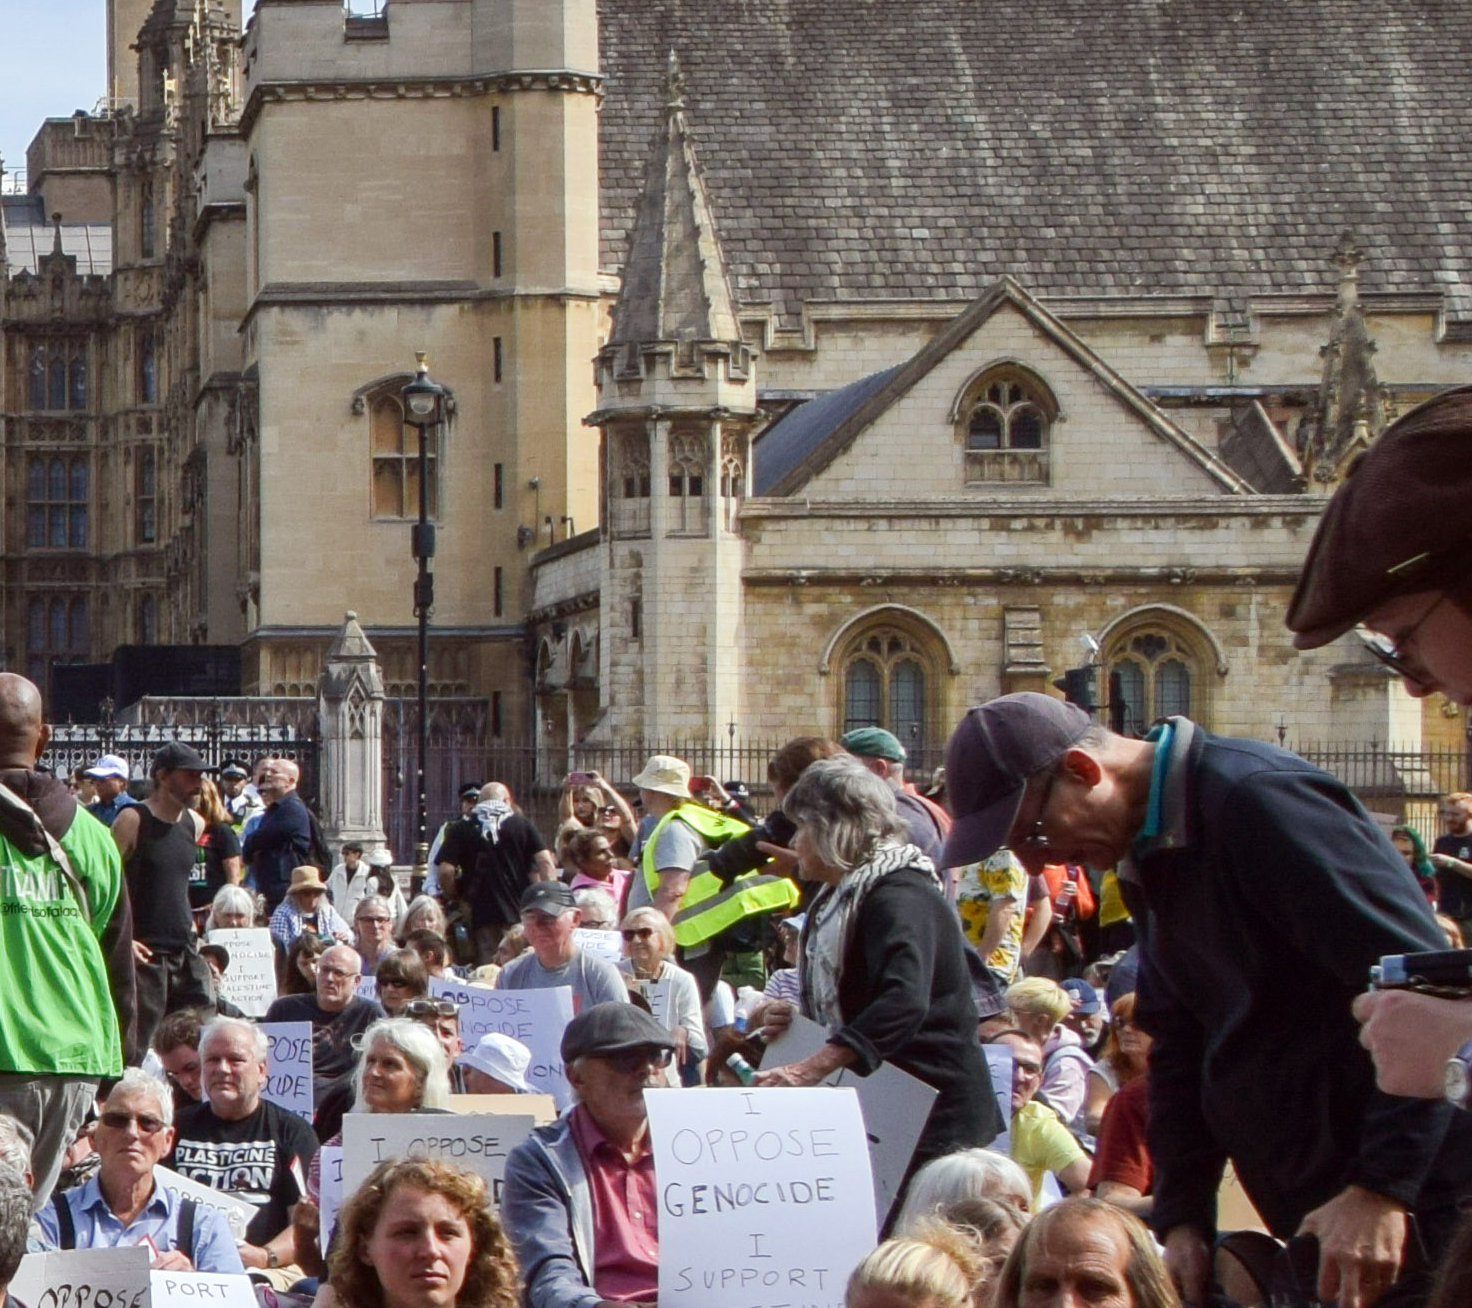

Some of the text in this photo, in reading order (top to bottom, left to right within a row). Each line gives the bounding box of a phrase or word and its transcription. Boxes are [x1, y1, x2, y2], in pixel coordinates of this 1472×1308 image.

[266, 1034, 313, 1063] POSE
[743, 1092, 761, 1115] I
[175, 1144, 276, 1166] PLASTICINE
[371, 1135, 507, 1163] I OPPOSE
[671, 1128, 841, 1167] OPPOSE
[178, 1165, 274, 1191] ACTION
[664, 1177, 836, 1218] GENOCIDE
[749, 1233, 773, 1258] I
[165, 1280, 229, 1299] PORT
[673, 1266, 829, 1293] SUPPORT
